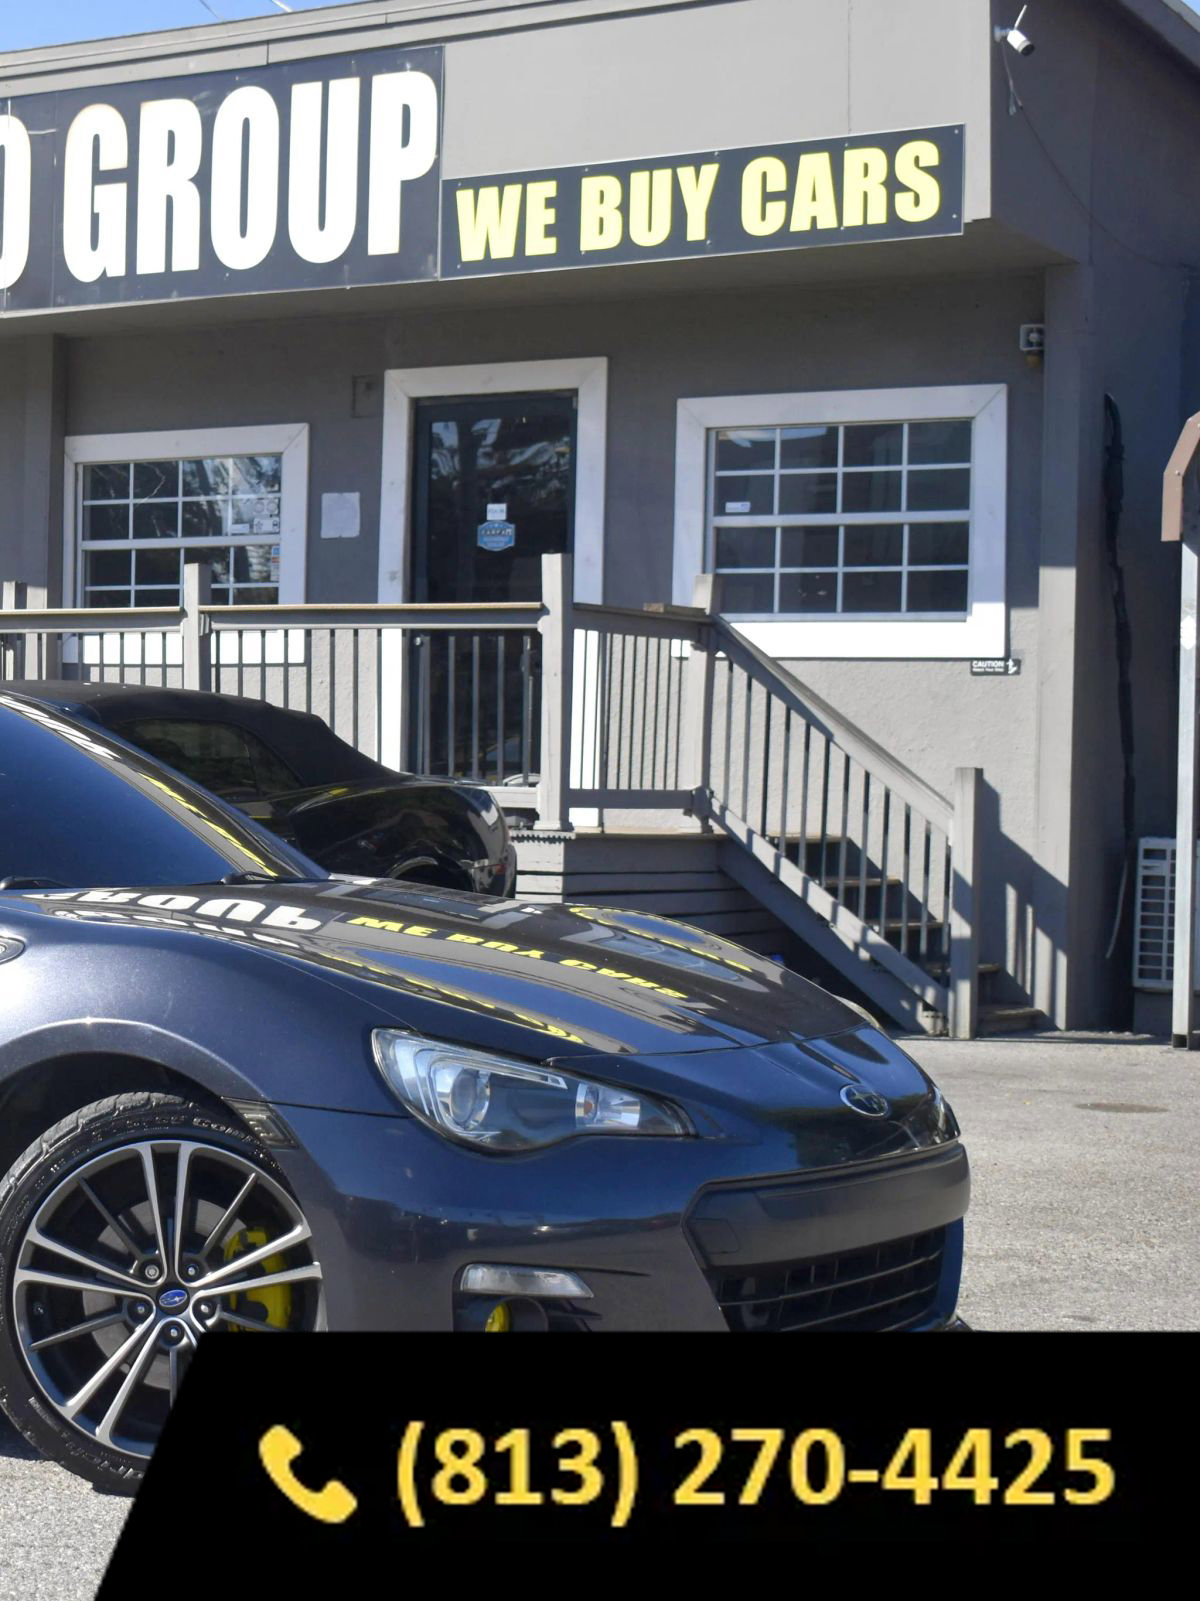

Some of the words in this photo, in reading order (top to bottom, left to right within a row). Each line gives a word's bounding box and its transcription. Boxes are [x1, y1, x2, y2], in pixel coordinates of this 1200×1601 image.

[63, 70, 438, 283] GROUP
[456, 180, 557, 262] WE
[580, 161, 720, 251] BUY
[740, 140, 940, 236] CARS
[972, 660, 1005, 668] CAUTION
